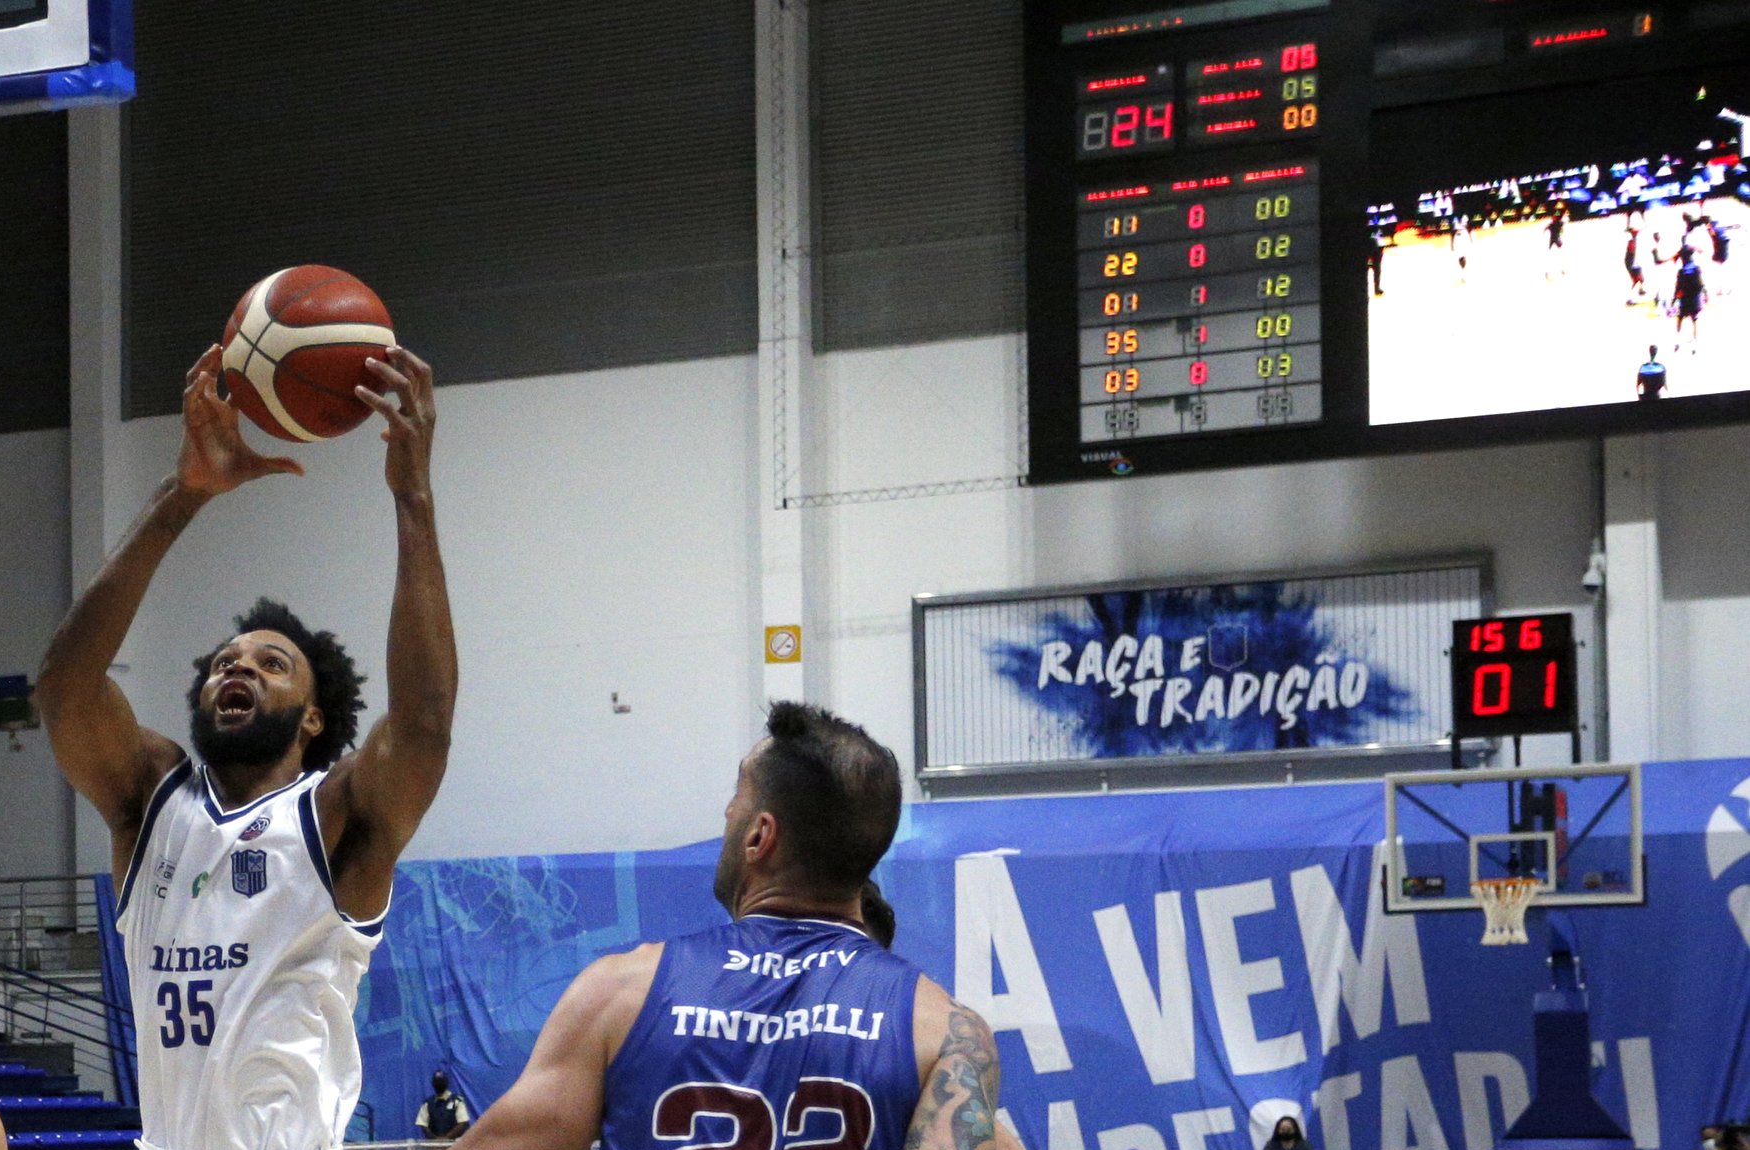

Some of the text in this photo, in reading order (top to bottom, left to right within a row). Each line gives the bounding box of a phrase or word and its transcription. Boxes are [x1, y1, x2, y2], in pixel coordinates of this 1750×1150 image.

[1280, 42, 1319, 73] 05
[1282, 75, 1317, 101] 05
[1111, 102, 1174, 148] 24
[1283, 103, 1318, 130] 00
[1107, 194, 1291, 237] 11 0 00
[1104, 234, 1291, 277] 22 0 02
[1104, 292, 1139, 316] 01
[1260, 273, 1291, 298] 12
[1104, 329, 1139, 355] 35
[1256, 313, 1292, 338] 00
[1104, 353, 1292, 394] 03 0 03
[1518, 618, 1543, 651] 6
[1036, 633, 1207, 699] RAÇA E
[1128, 648, 1371, 731] TRADIÇÃO
[1093, 834, 1431, 1087] VEM
[156, 979, 216, 1049] 35
